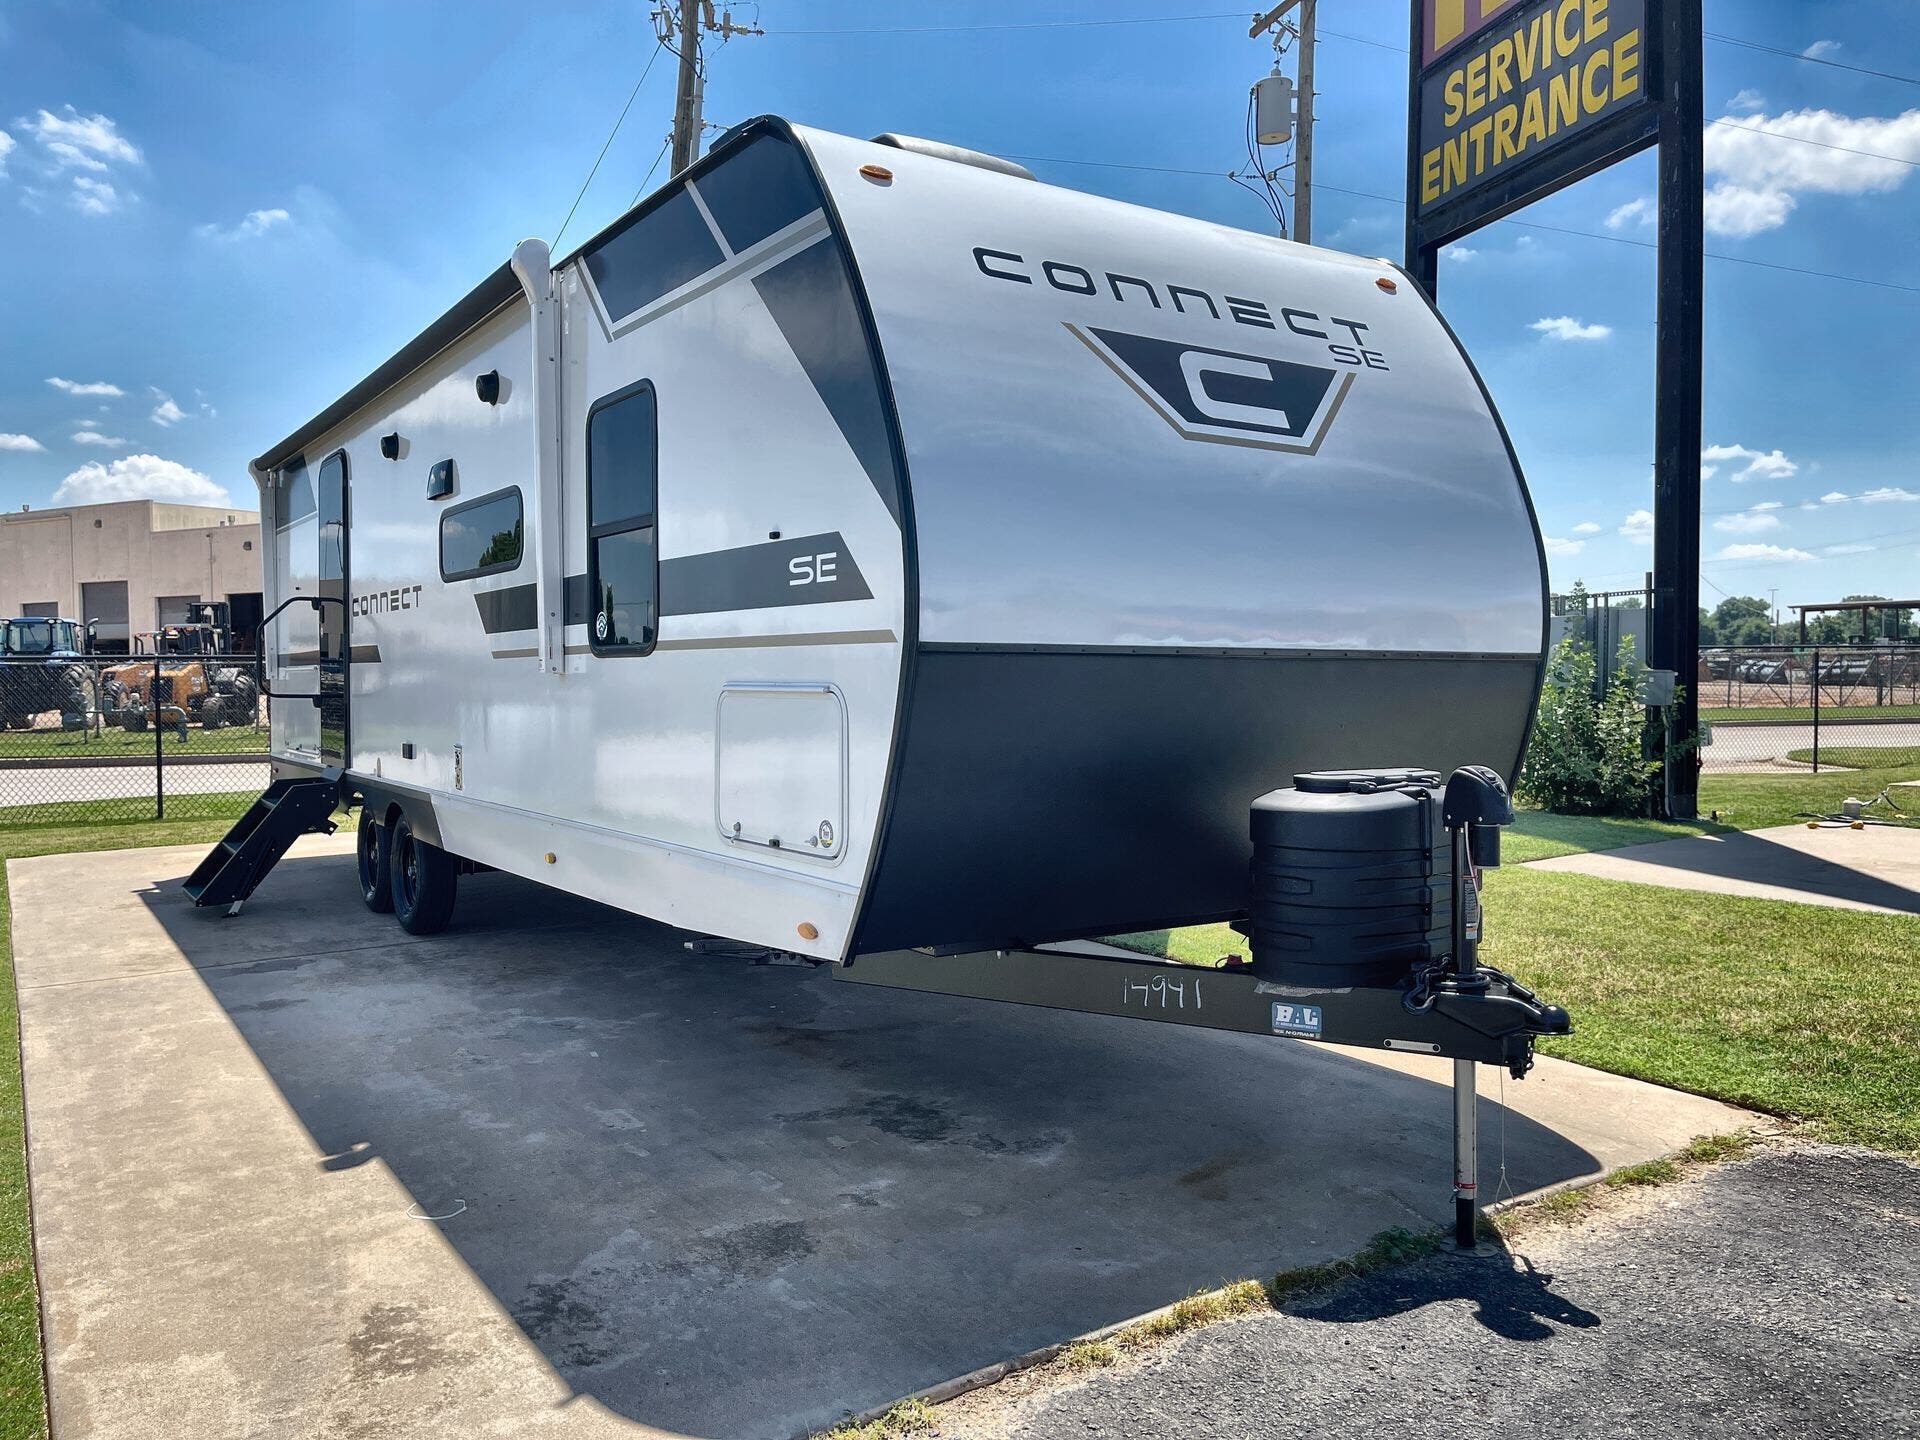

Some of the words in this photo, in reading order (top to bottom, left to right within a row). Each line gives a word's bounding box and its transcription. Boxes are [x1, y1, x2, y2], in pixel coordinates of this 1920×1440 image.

[1444, 0, 1609, 127] SERVICE
[1422, 29, 1639, 205] ENTRANCE
[972, 247, 1369, 346] CONNECT
[1328, 344, 1391, 371] SE
[352, 585, 422, 617] CONNECT
[789, 552, 837, 586] SE
